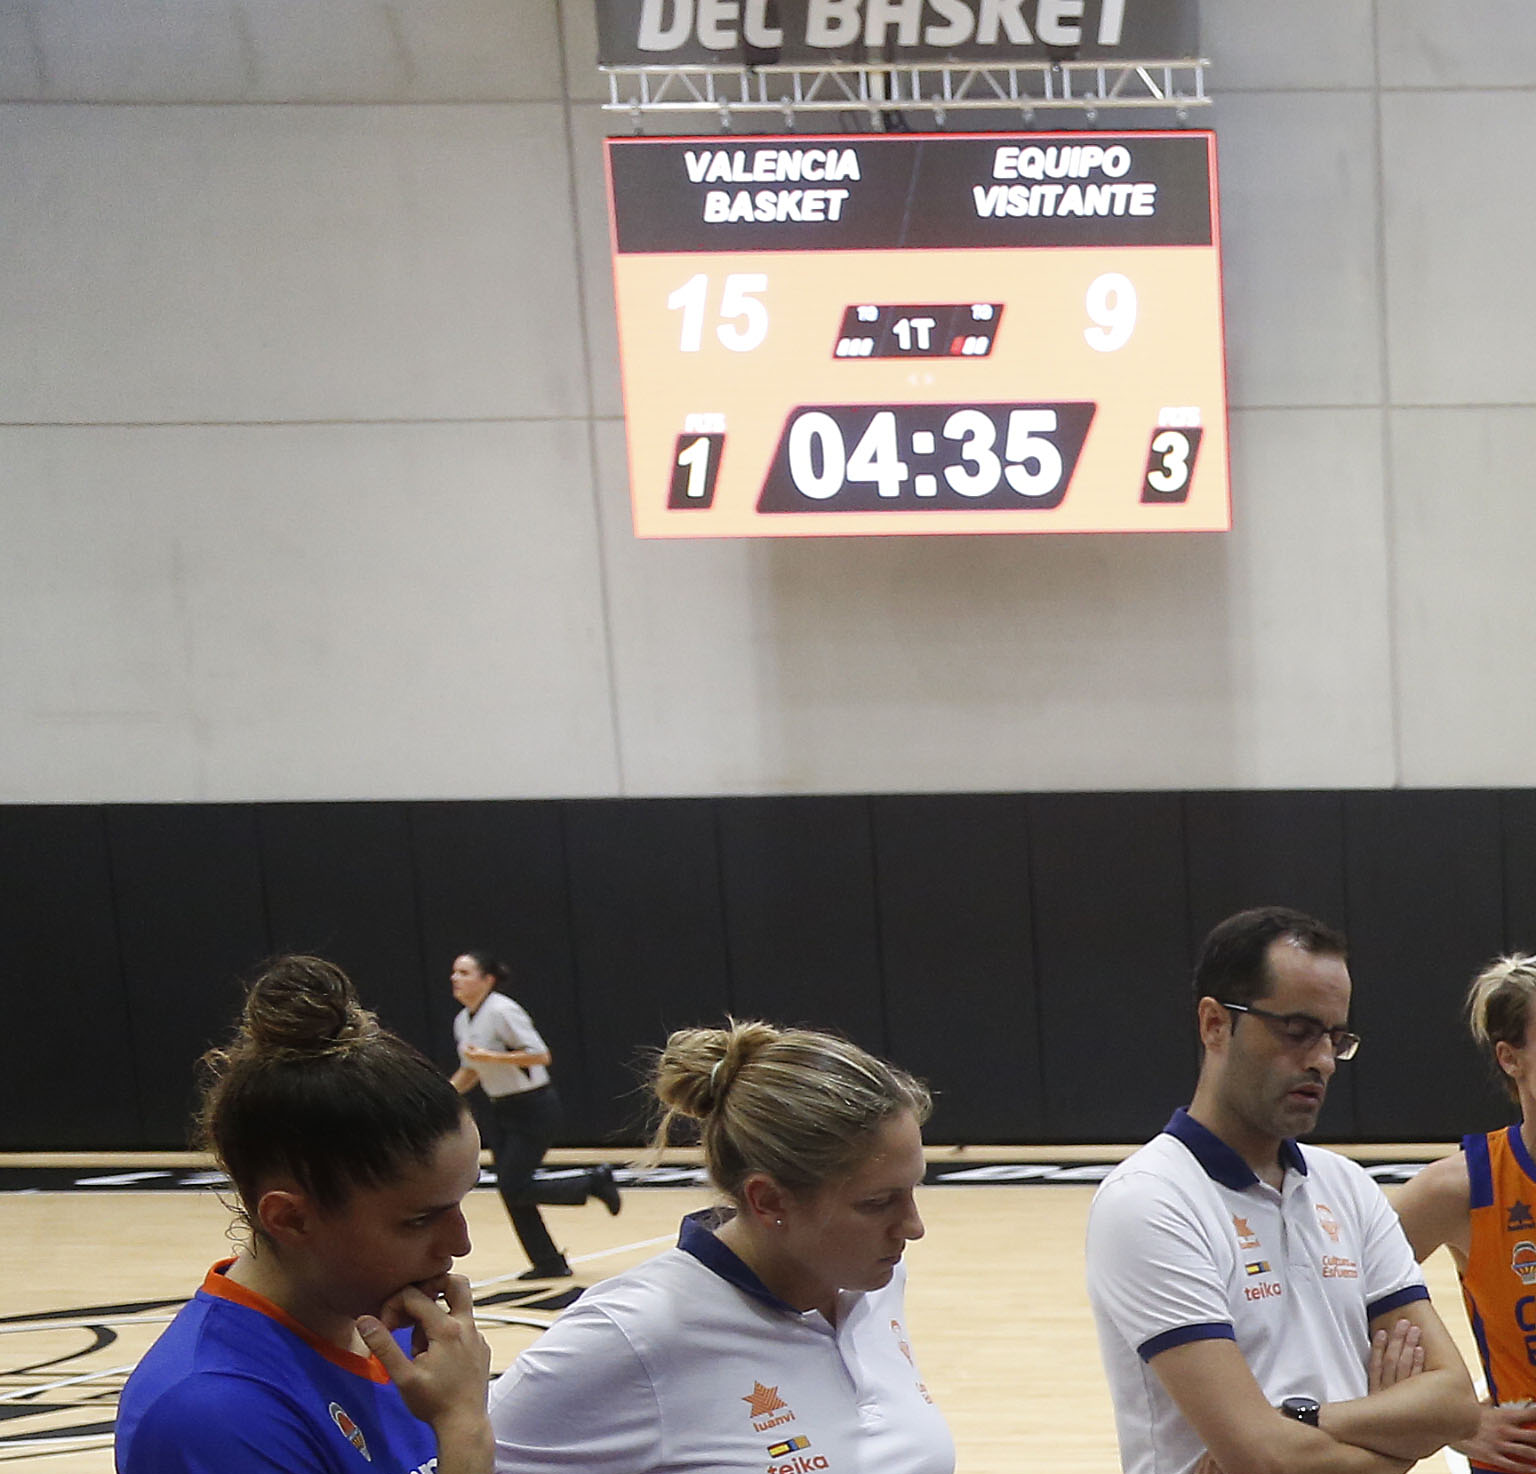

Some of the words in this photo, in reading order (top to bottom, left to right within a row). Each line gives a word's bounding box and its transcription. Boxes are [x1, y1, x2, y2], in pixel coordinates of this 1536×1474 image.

[637, 0, 783, 51] DEL
[804, 0, 1129, 48] BASKET
[683, 148, 862, 183] VALENCIA
[992, 146, 1132, 181] EQUIPO
[703, 188, 850, 223] BASKET
[972, 184, 1157, 218] VISITANTE
[666, 272, 770, 354] 15
[1082, 272, 1139, 354] 9
[892, 316, 937, 351] 1T
[675, 436, 711, 499] 1
[787, 408, 1063, 500] 04:35
[1145, 430, 1191, 495] 3
[1244, 1281, 1283, 1302] teika
[751, 1409, 797, 1434] luanvi
